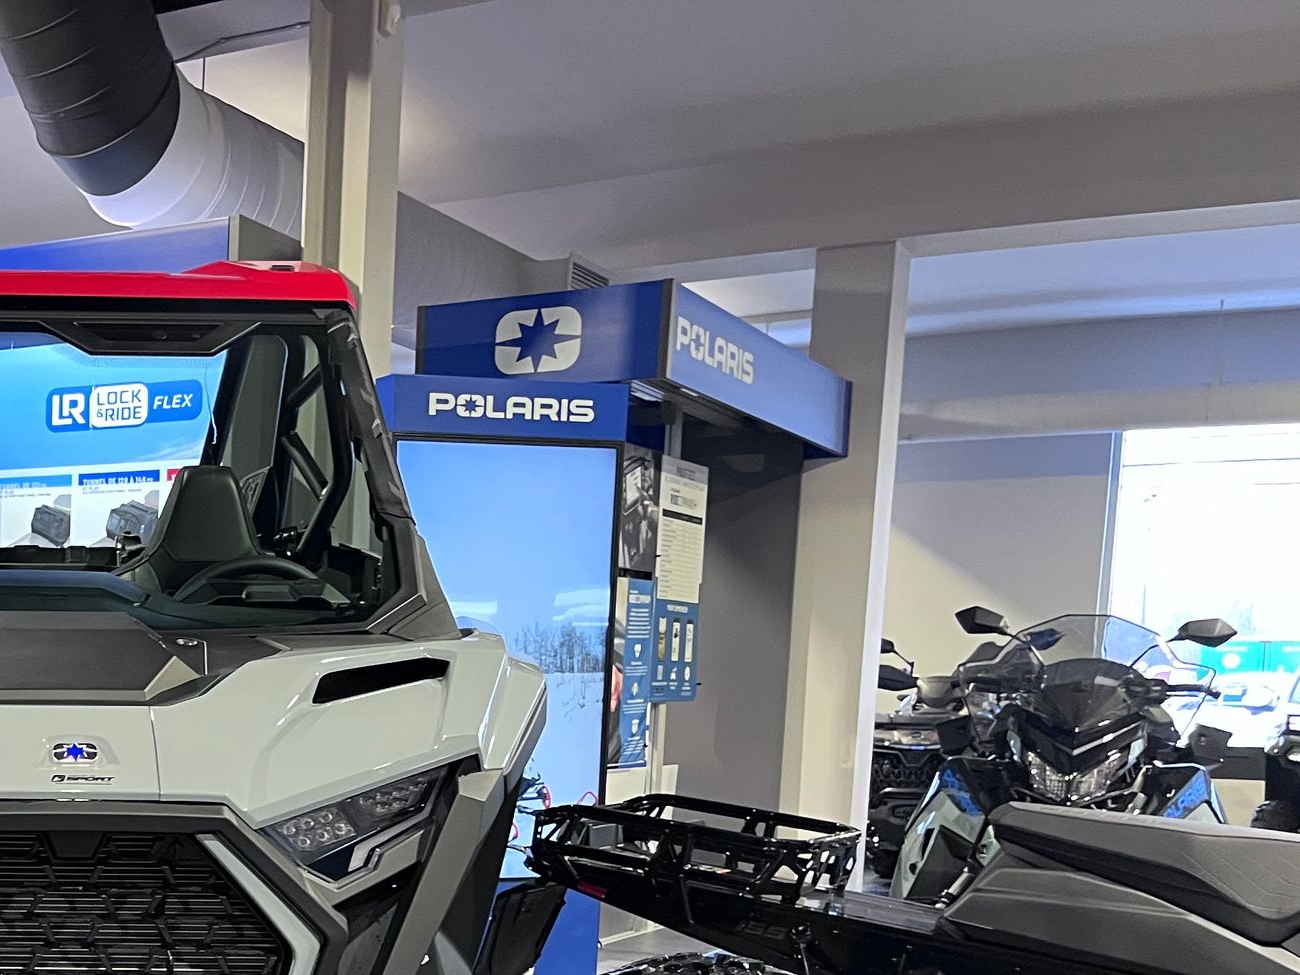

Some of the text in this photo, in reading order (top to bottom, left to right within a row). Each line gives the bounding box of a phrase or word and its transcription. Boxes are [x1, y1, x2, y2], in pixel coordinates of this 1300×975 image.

[676, 315, 754, 385] POLARIS
[51, 393, 86, 426] LR
[96, 389, 142, 406] LOCK
[153, 393, 193, 410] FLEX
[428, 392, 595, 423] POLARIS
